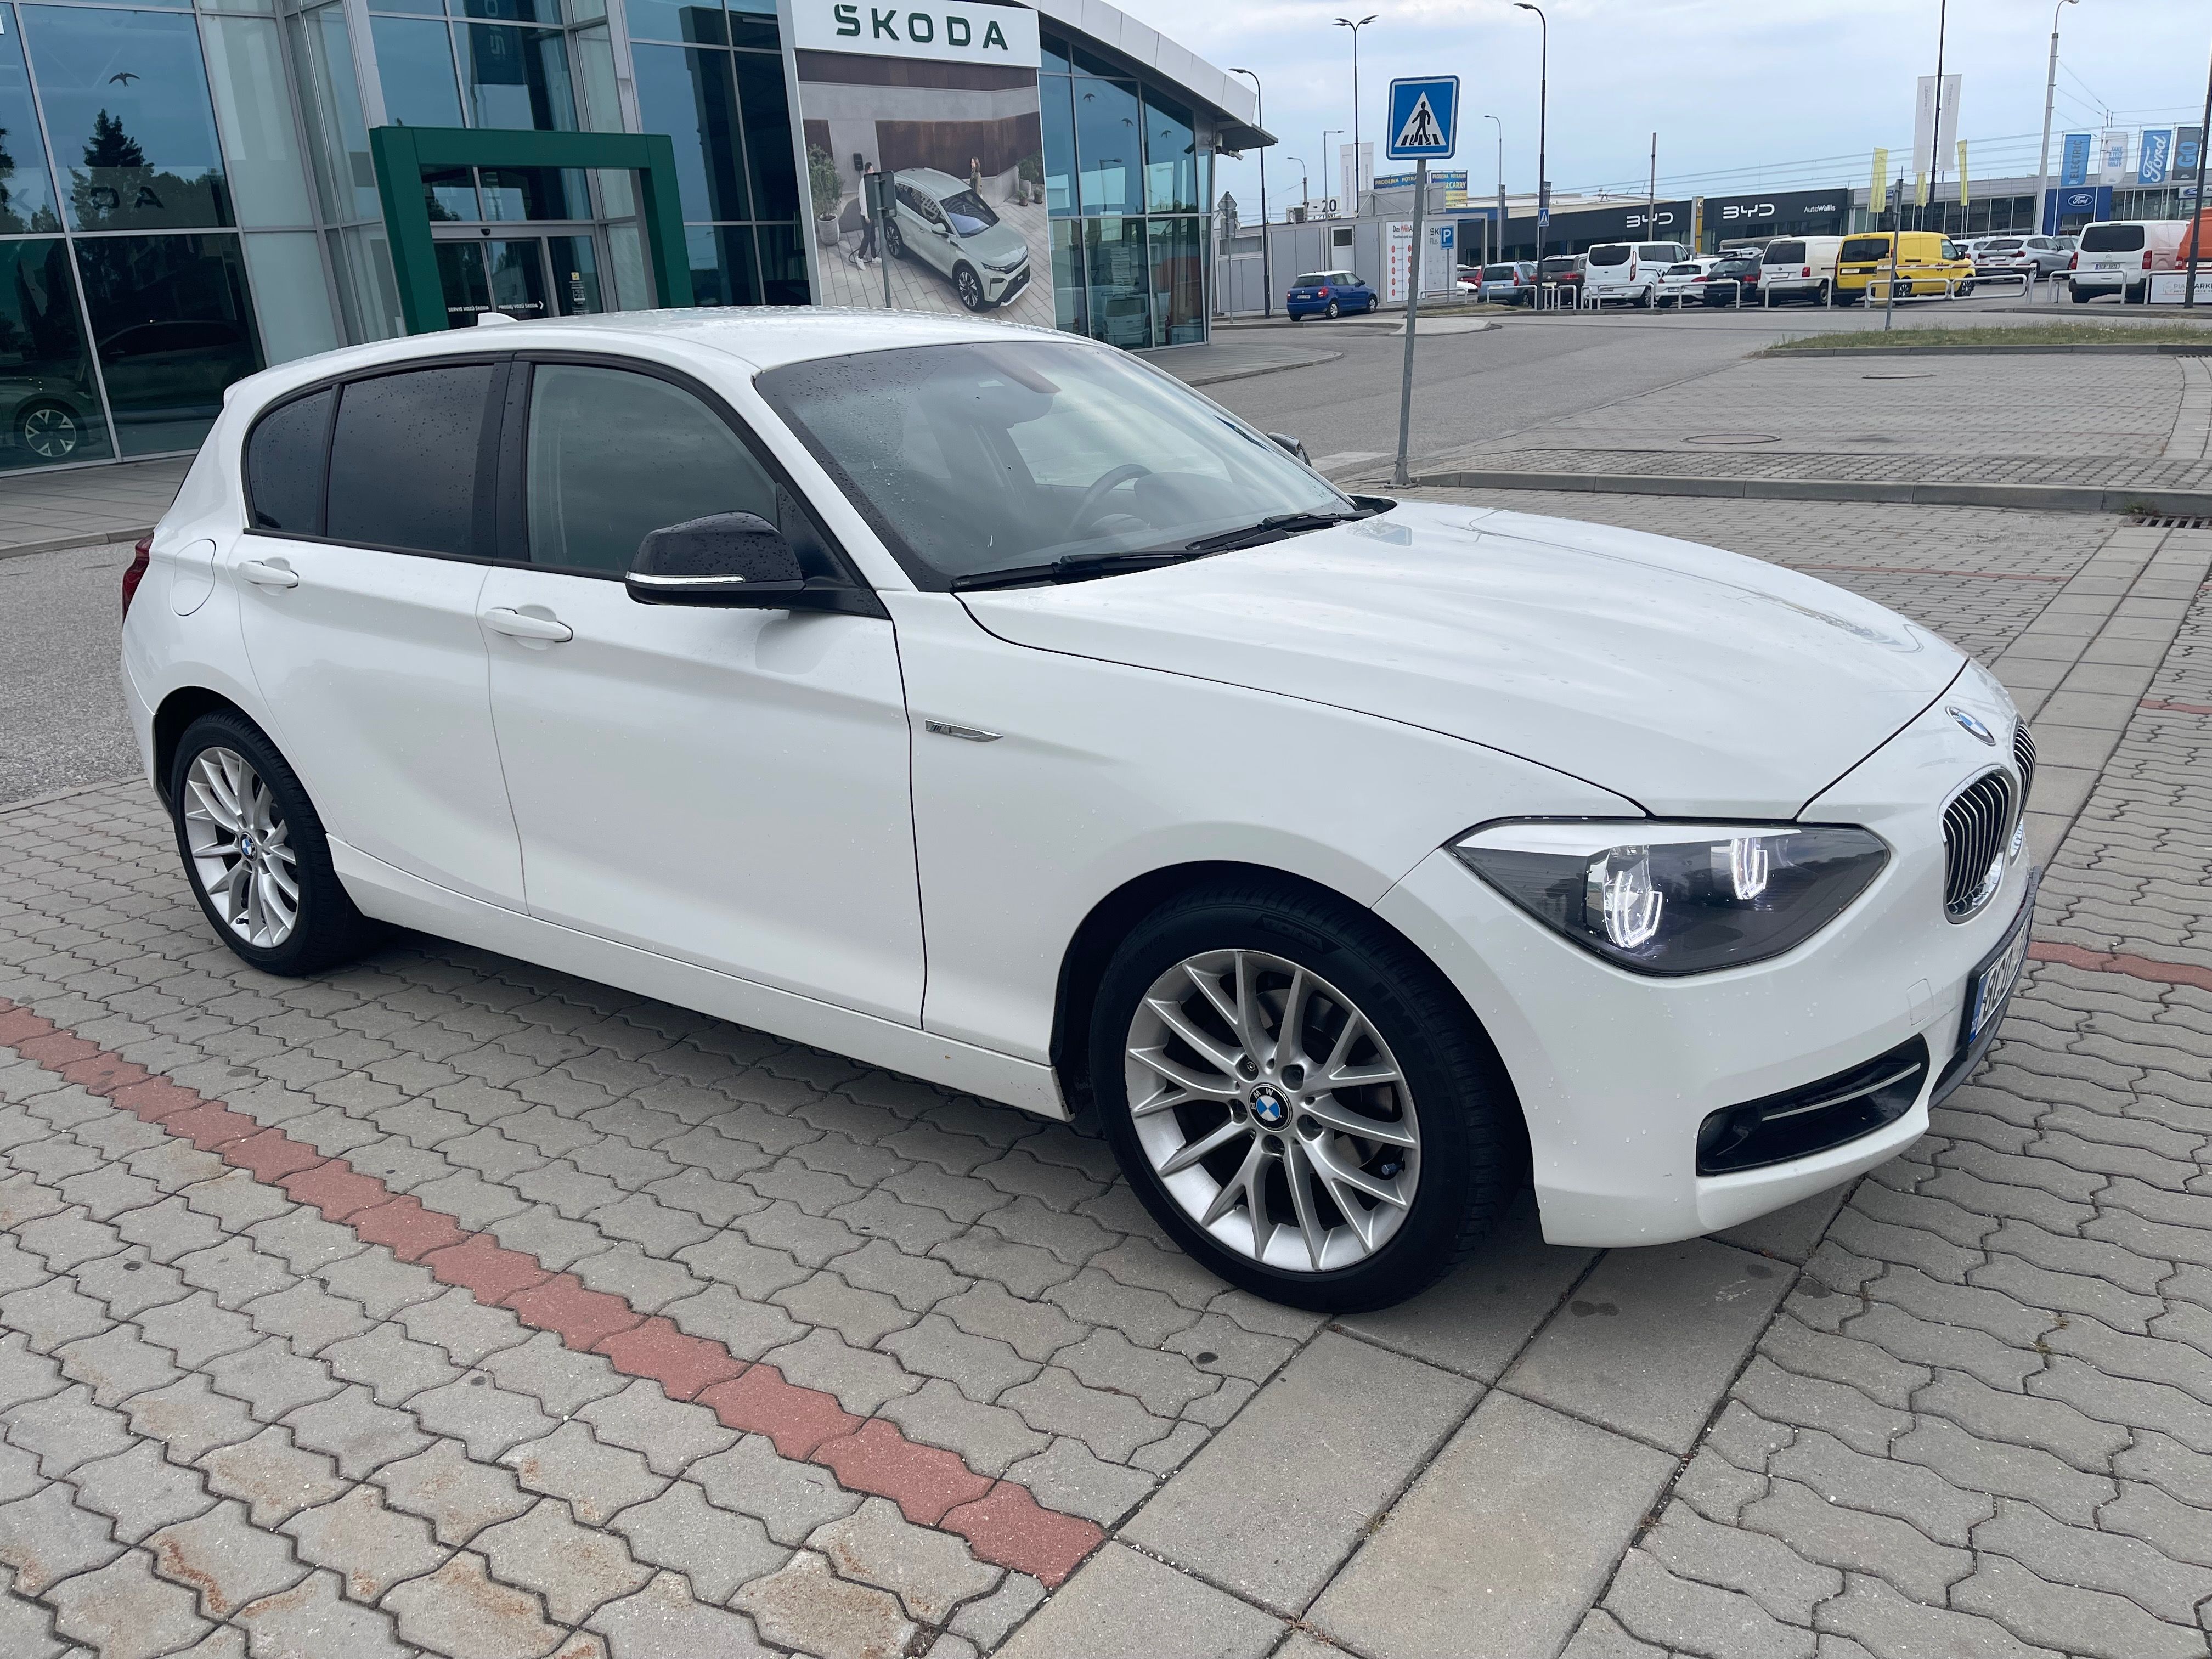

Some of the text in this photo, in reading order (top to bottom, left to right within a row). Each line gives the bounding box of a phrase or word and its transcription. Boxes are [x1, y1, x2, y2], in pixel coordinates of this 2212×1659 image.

[2069, 140, 2082, 179] ELECTRIC
[2142, 135, 2166, 183] Ford
[2177, 141, 2198, 167] GO
[1723, 203, 1775, 219] BYD
[1804, 204, 1836, 213] AutoWallis
[1626, 212, 1674, 228] BYD
[1250, 1088, 1273, 1110] BMW
